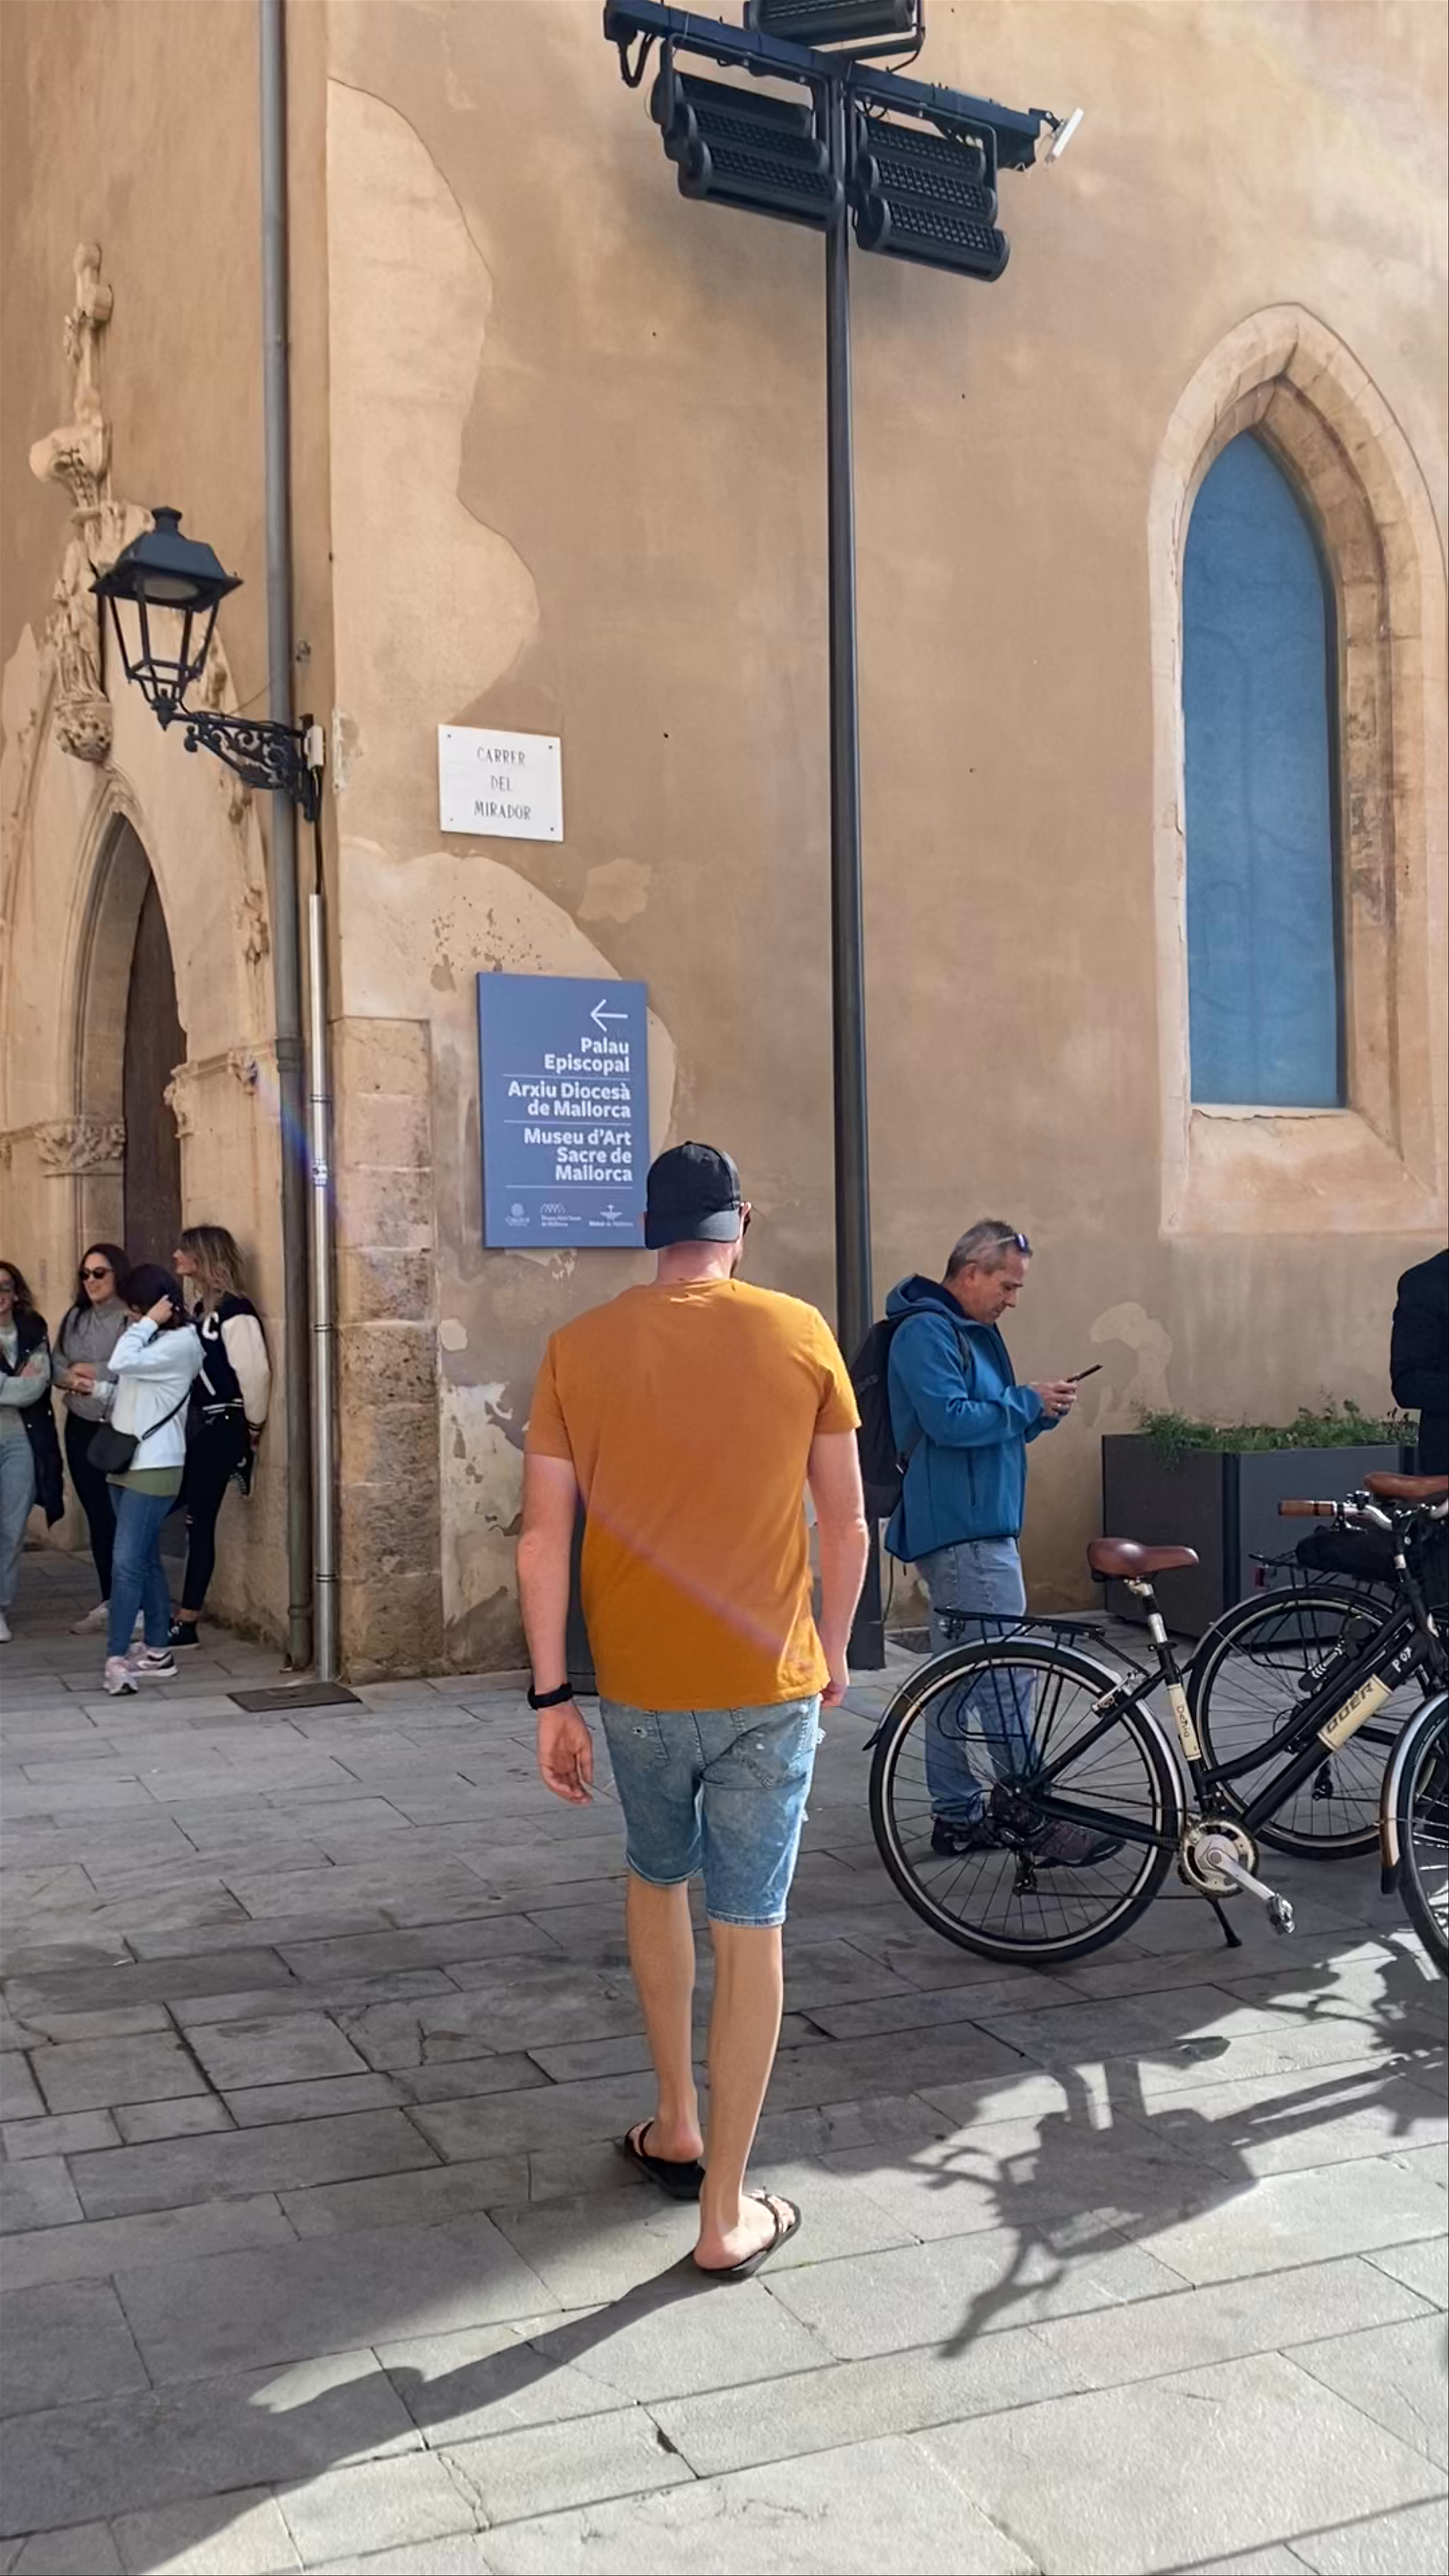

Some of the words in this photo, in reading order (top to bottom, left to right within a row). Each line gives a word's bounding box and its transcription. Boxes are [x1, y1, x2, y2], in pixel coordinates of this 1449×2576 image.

[477, 747, 526, 766] CARRER
[491, 775, 512, 792] DEL
[474, 800, 531, 820] MIRADOR
[581, 1037, 629, 1055] Palau
[544, 1053, 629, 1076] Episcopal
[508, 1080, 557, 1098] Arxiu
[561, 1081, 631, 1100] Diocesà
[528, 1099, 550, 1116] de
[554, 1100, 631, 1118] Mallorca
[524, 1127, 584, 1145] Museu
[557, 1146, 607, 1163] Sacre
[610, 1147, 632, 1164] de
[555, 1164, 633, 1181] Mallorca
